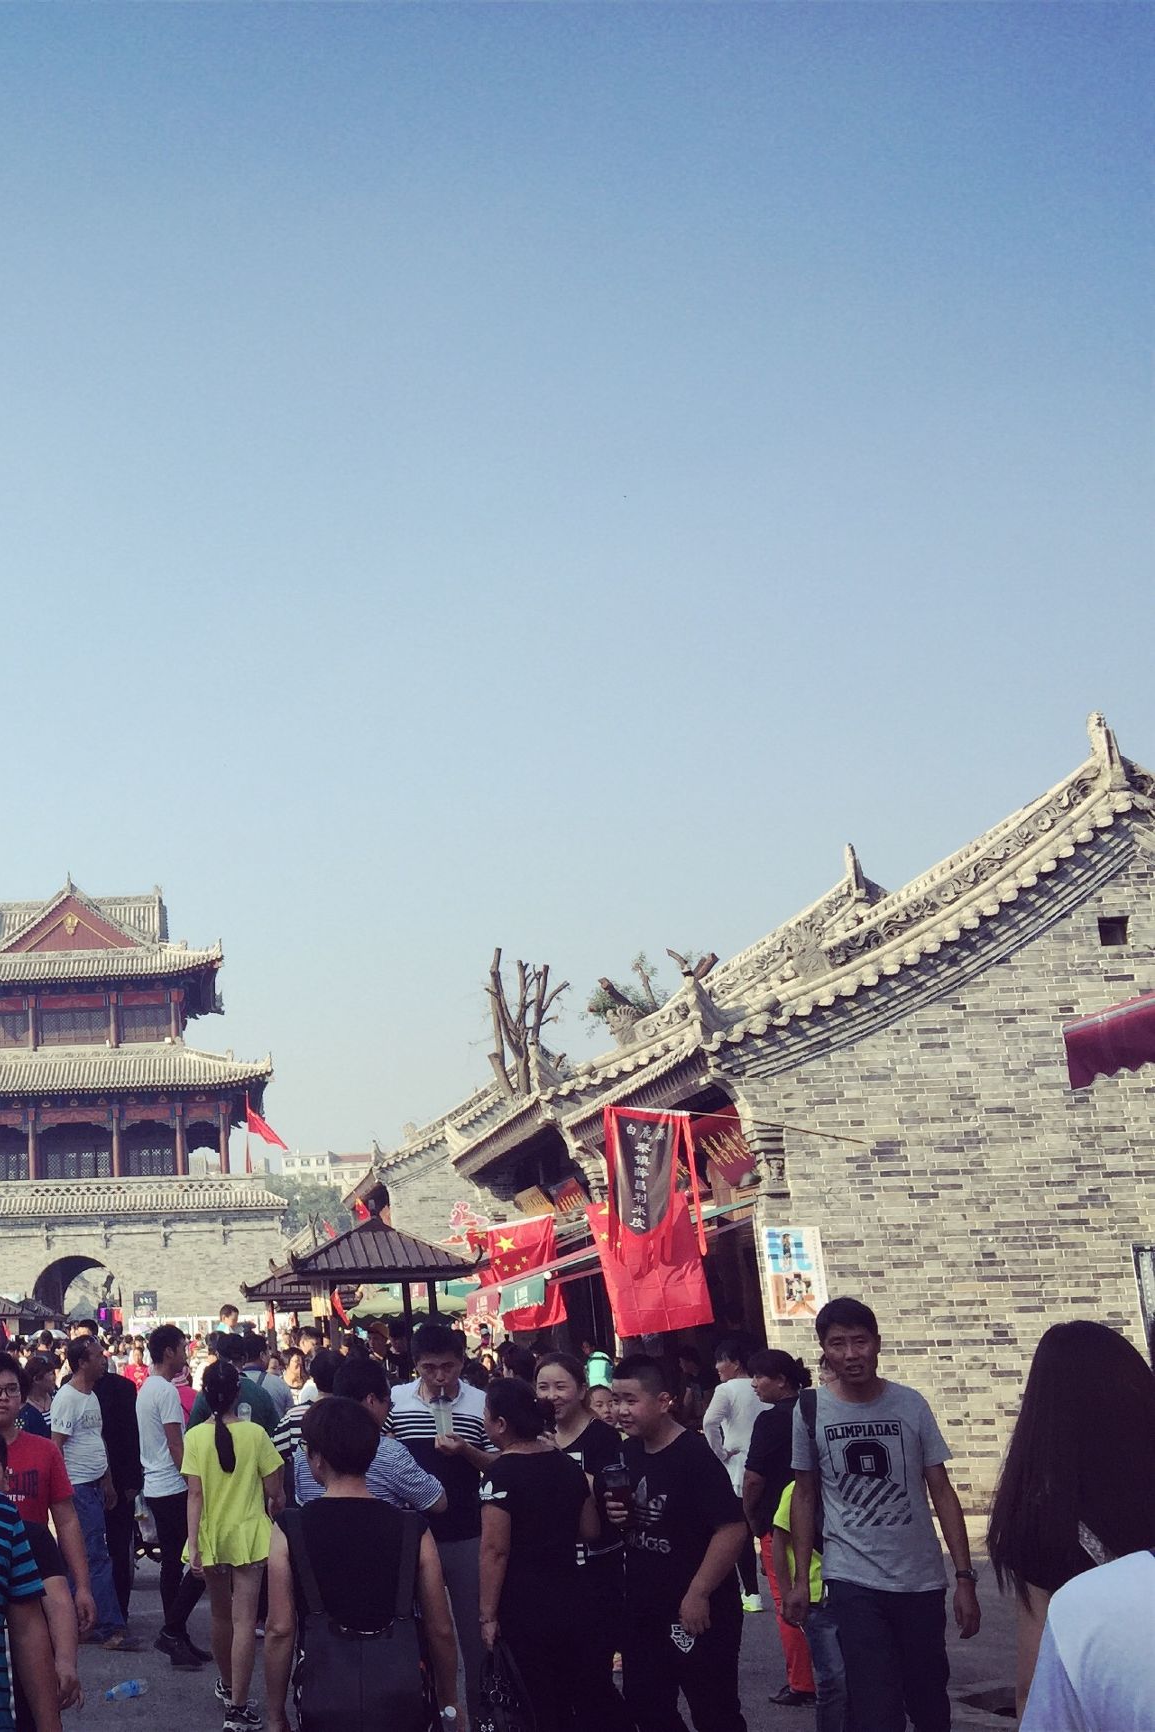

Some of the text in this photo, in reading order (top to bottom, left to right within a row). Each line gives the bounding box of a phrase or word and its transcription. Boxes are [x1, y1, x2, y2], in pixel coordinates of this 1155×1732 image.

[626, 1123, 666, 1140] 白鹿原
[827, 1423, 900, 1441] OLIMPIADAS
